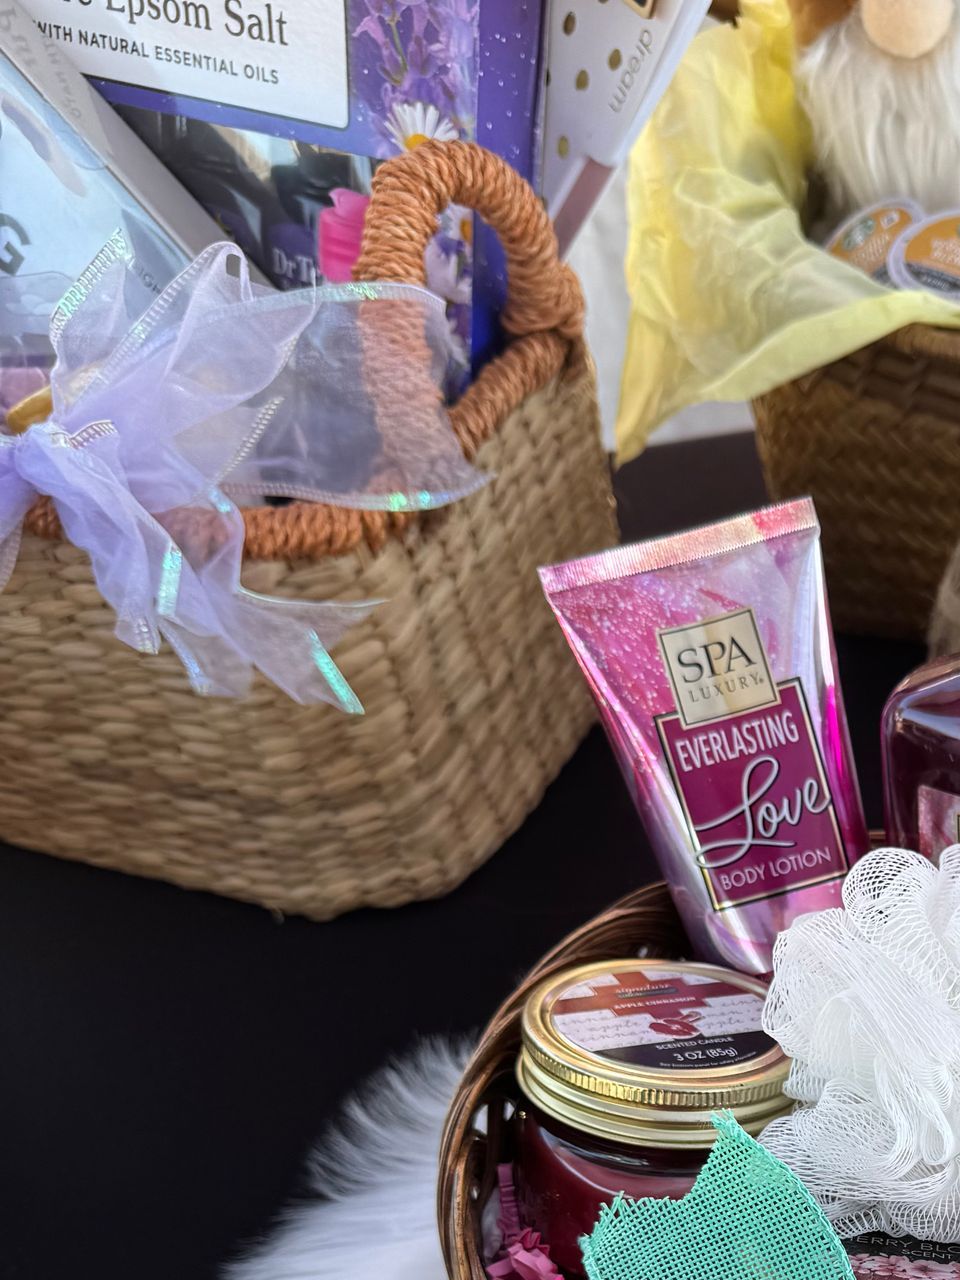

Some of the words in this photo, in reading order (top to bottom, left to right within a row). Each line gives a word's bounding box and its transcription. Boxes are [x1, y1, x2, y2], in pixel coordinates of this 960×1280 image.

[224, 0, 289, 46] Salt
[78, 29, 149, 58] NATURAL
[155, 45, 238, 77] ESSENTIAL
[244, 63, 280, 85] OILS
[677, 636, 757, 684] SPA
[688, 671, 761, 703] LUXURY
[675, 711, 800, 773] EVERLASTING
[695, 755, 832, 868] Love
[721, 864, 766, 891] BODY
[770, 847, 832, 878] LOTION
[656, 1040, 697, 1050] SCENTED
[698, 1037, 734, 1045] CANDLE
[673, 1053, 684, 1062] 3
[684, 1050, 706, 1060] OZ
[706, 1046, 738, 1059] (85g)
[850, 1235, 913, 1248] ERRY
[901, 1249, 953, 1260] SCENT
